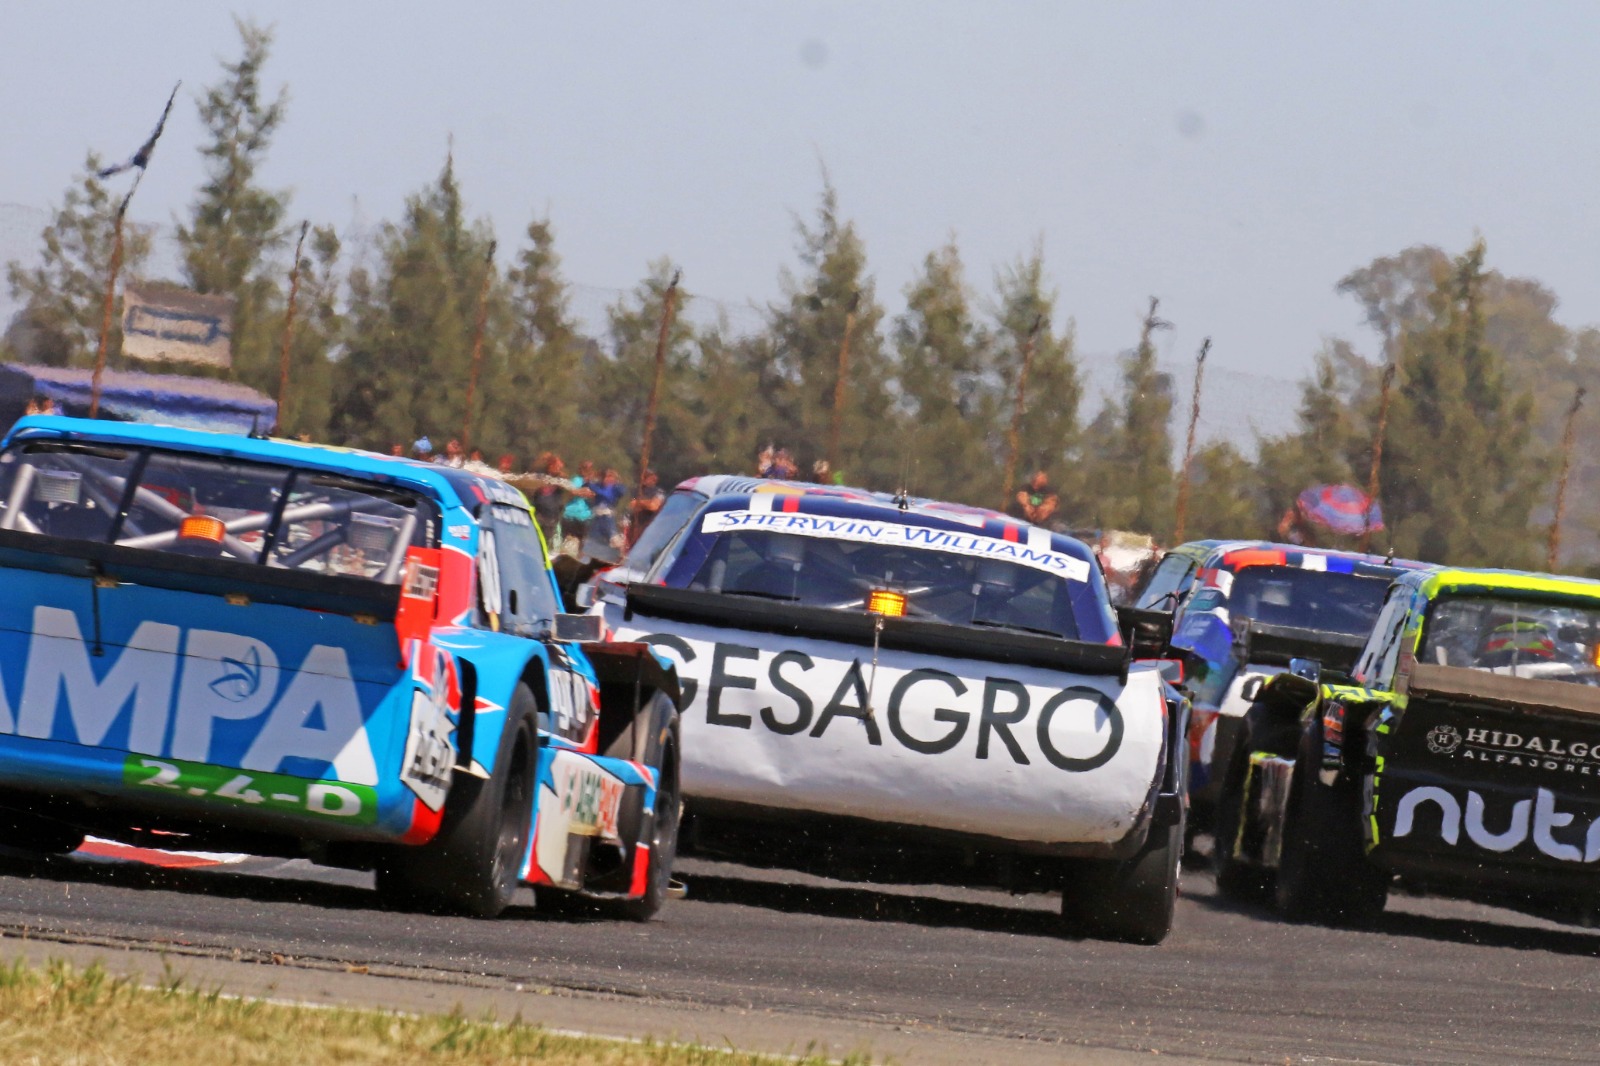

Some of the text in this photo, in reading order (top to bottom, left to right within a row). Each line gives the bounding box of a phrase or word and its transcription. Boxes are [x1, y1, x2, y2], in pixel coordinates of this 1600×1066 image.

[718, 511, 1069, 569] SHERWIN-WILLIAMS
[0, 605, 379, 786] MPA
[139, 759, 362, 816] 2.4-D
